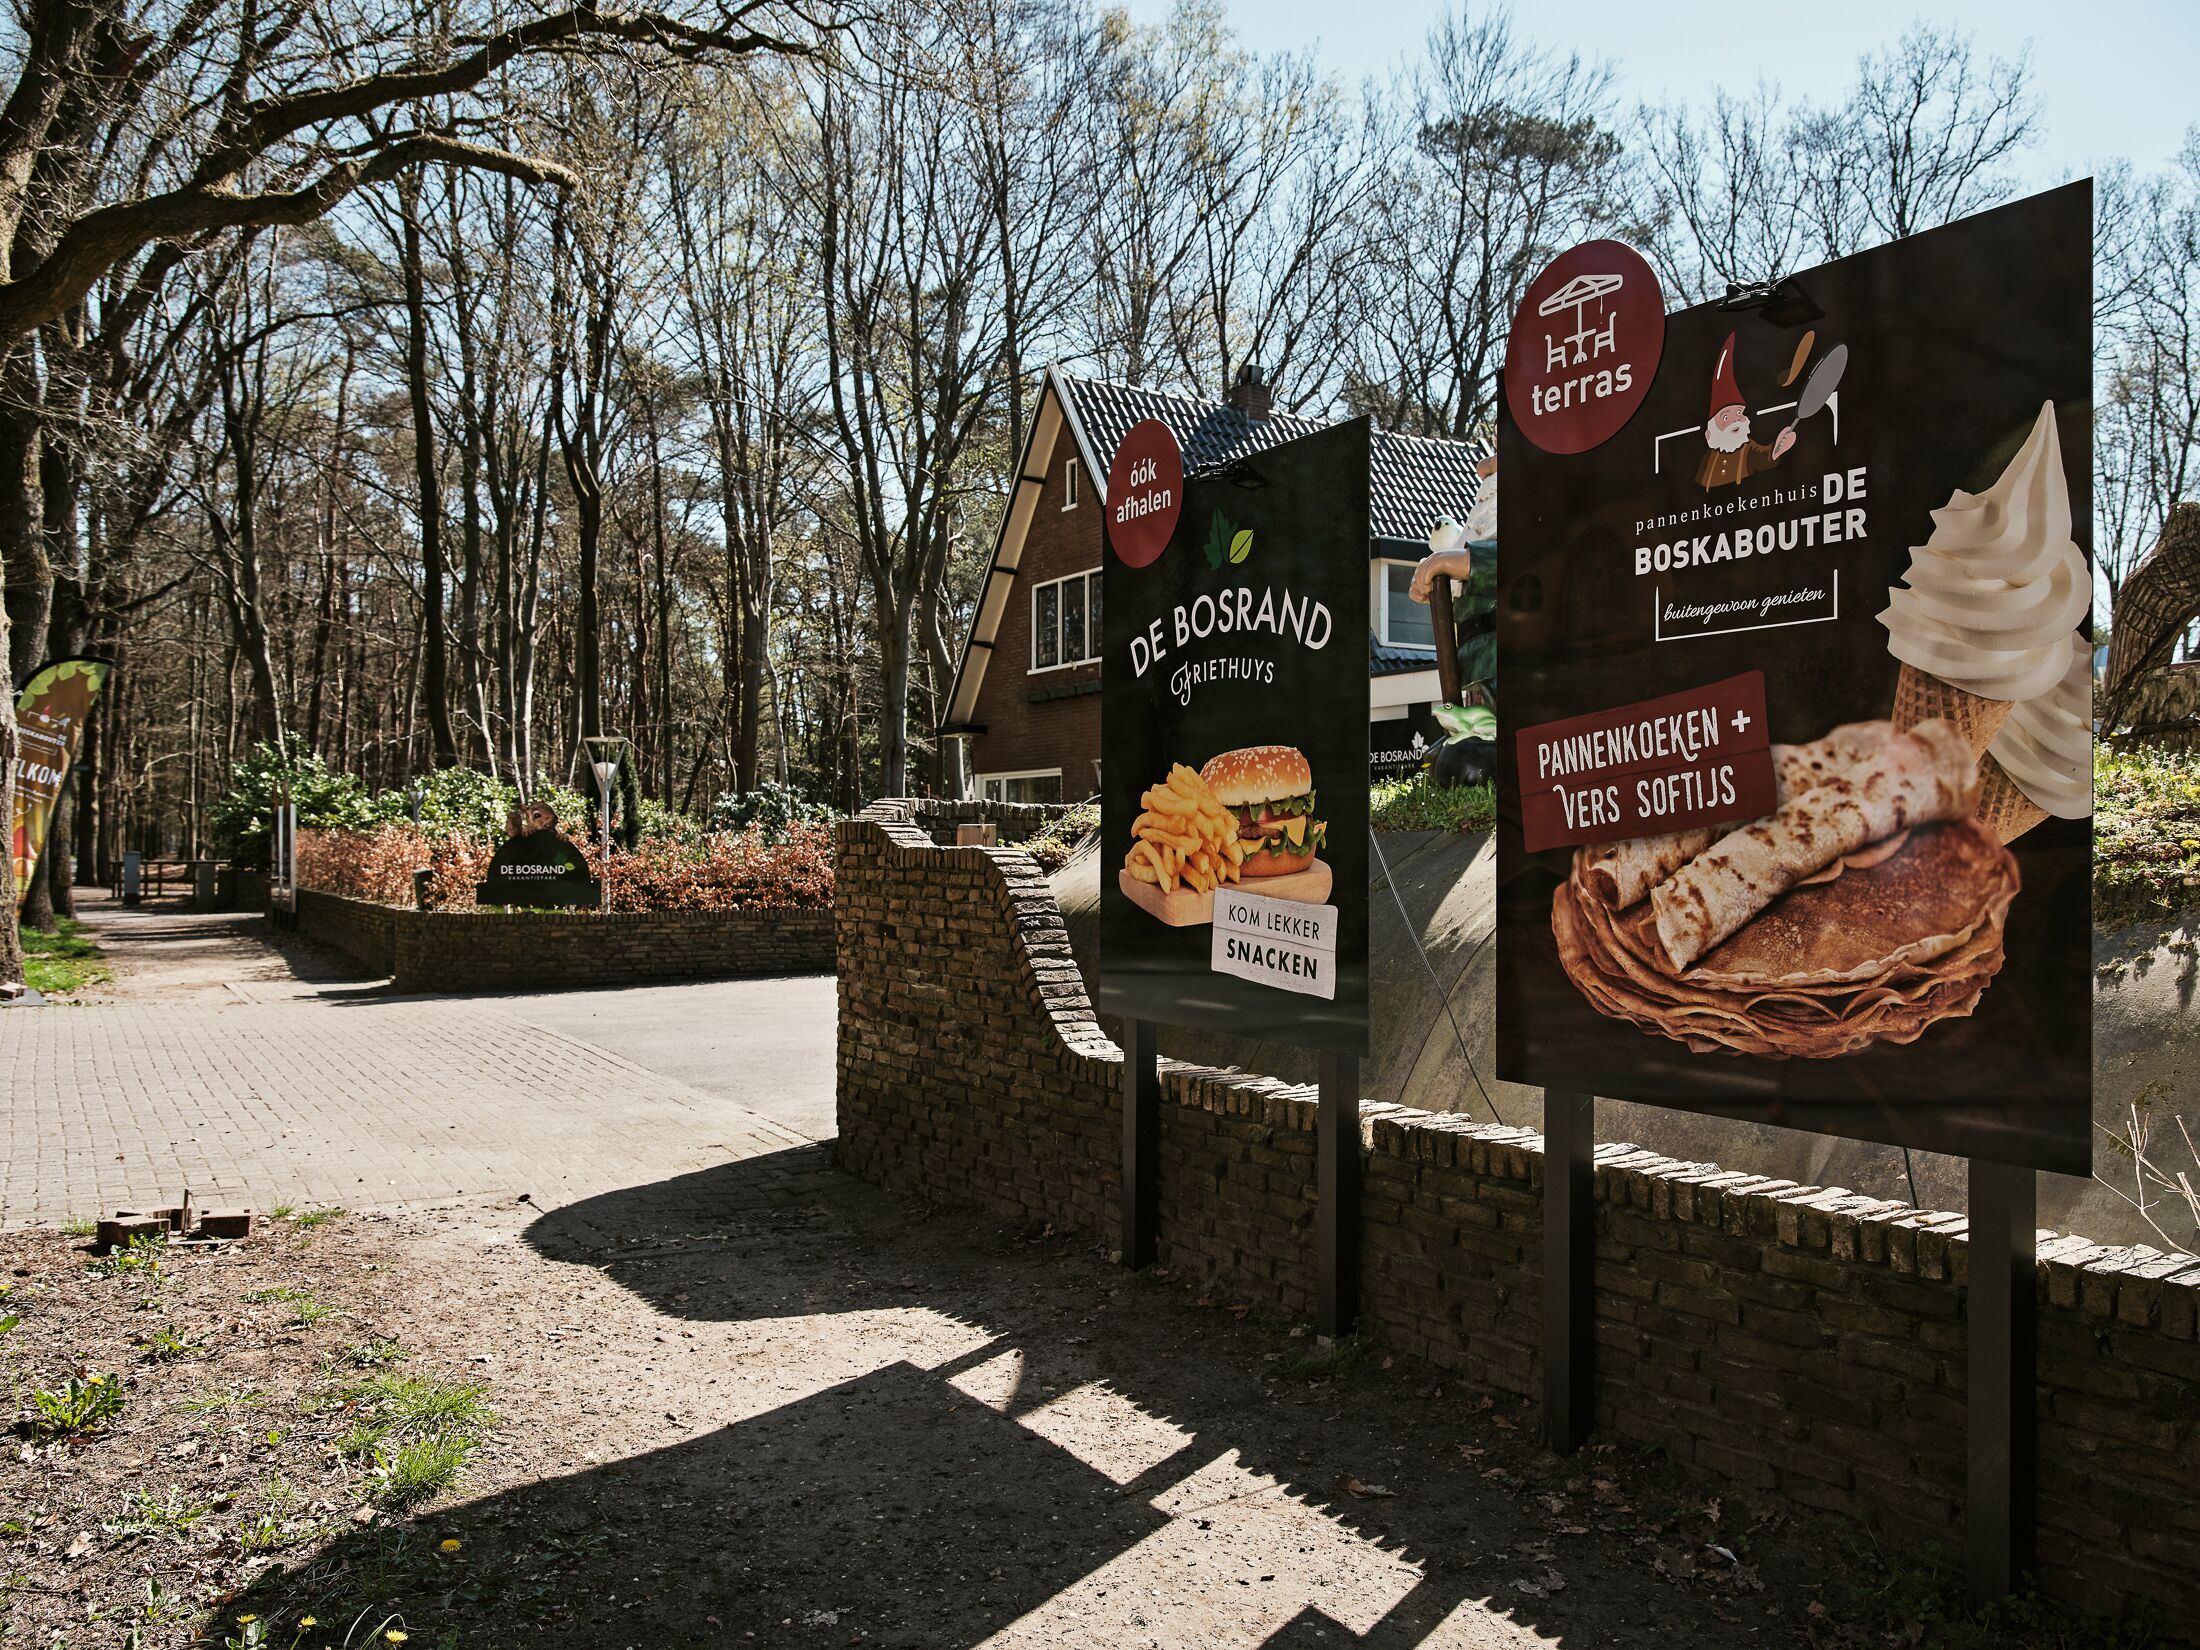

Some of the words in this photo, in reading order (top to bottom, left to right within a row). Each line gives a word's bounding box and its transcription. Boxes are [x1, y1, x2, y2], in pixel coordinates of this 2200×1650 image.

[1531, 363, 1633, 416] terras
[1130, 458, 1157, 488] óók
[1116, 489, 1171, 523] afhalen
[1635, 485, 1817, 536] pannenkoekenhuis
[1823, 466, 1867, 505] DE
[1635, 507, 1868, 576] BOSKABOUTER
[1663, 599, 1759, 625] buitengewoon
[1759, 587, 1826, 617] genieten
[1130, 618, 1166, 678] DE
[1173, 586, 1332, 650] BOSRAND
[1170, 657, 1275, 706] FRIETHUYS
[1380, 748, 1422, 763] BOSRAND
[1538, 706, 1720, 780] PANNENKOEKEN
[17, 759, 62, 788] LKOM
[1552, 784, 1620, 830] VERS
[1636, 765, 1736, 818] SOFTIJS
[500, 865, 514, 875] DE
[515, 865, 565, 875] BOSRAND
[1228, 904, 1260, 927] KOM
[1267, 912, 1320, 941] LEKKER
[1226, 937, 1318, 980] SNACKEN
